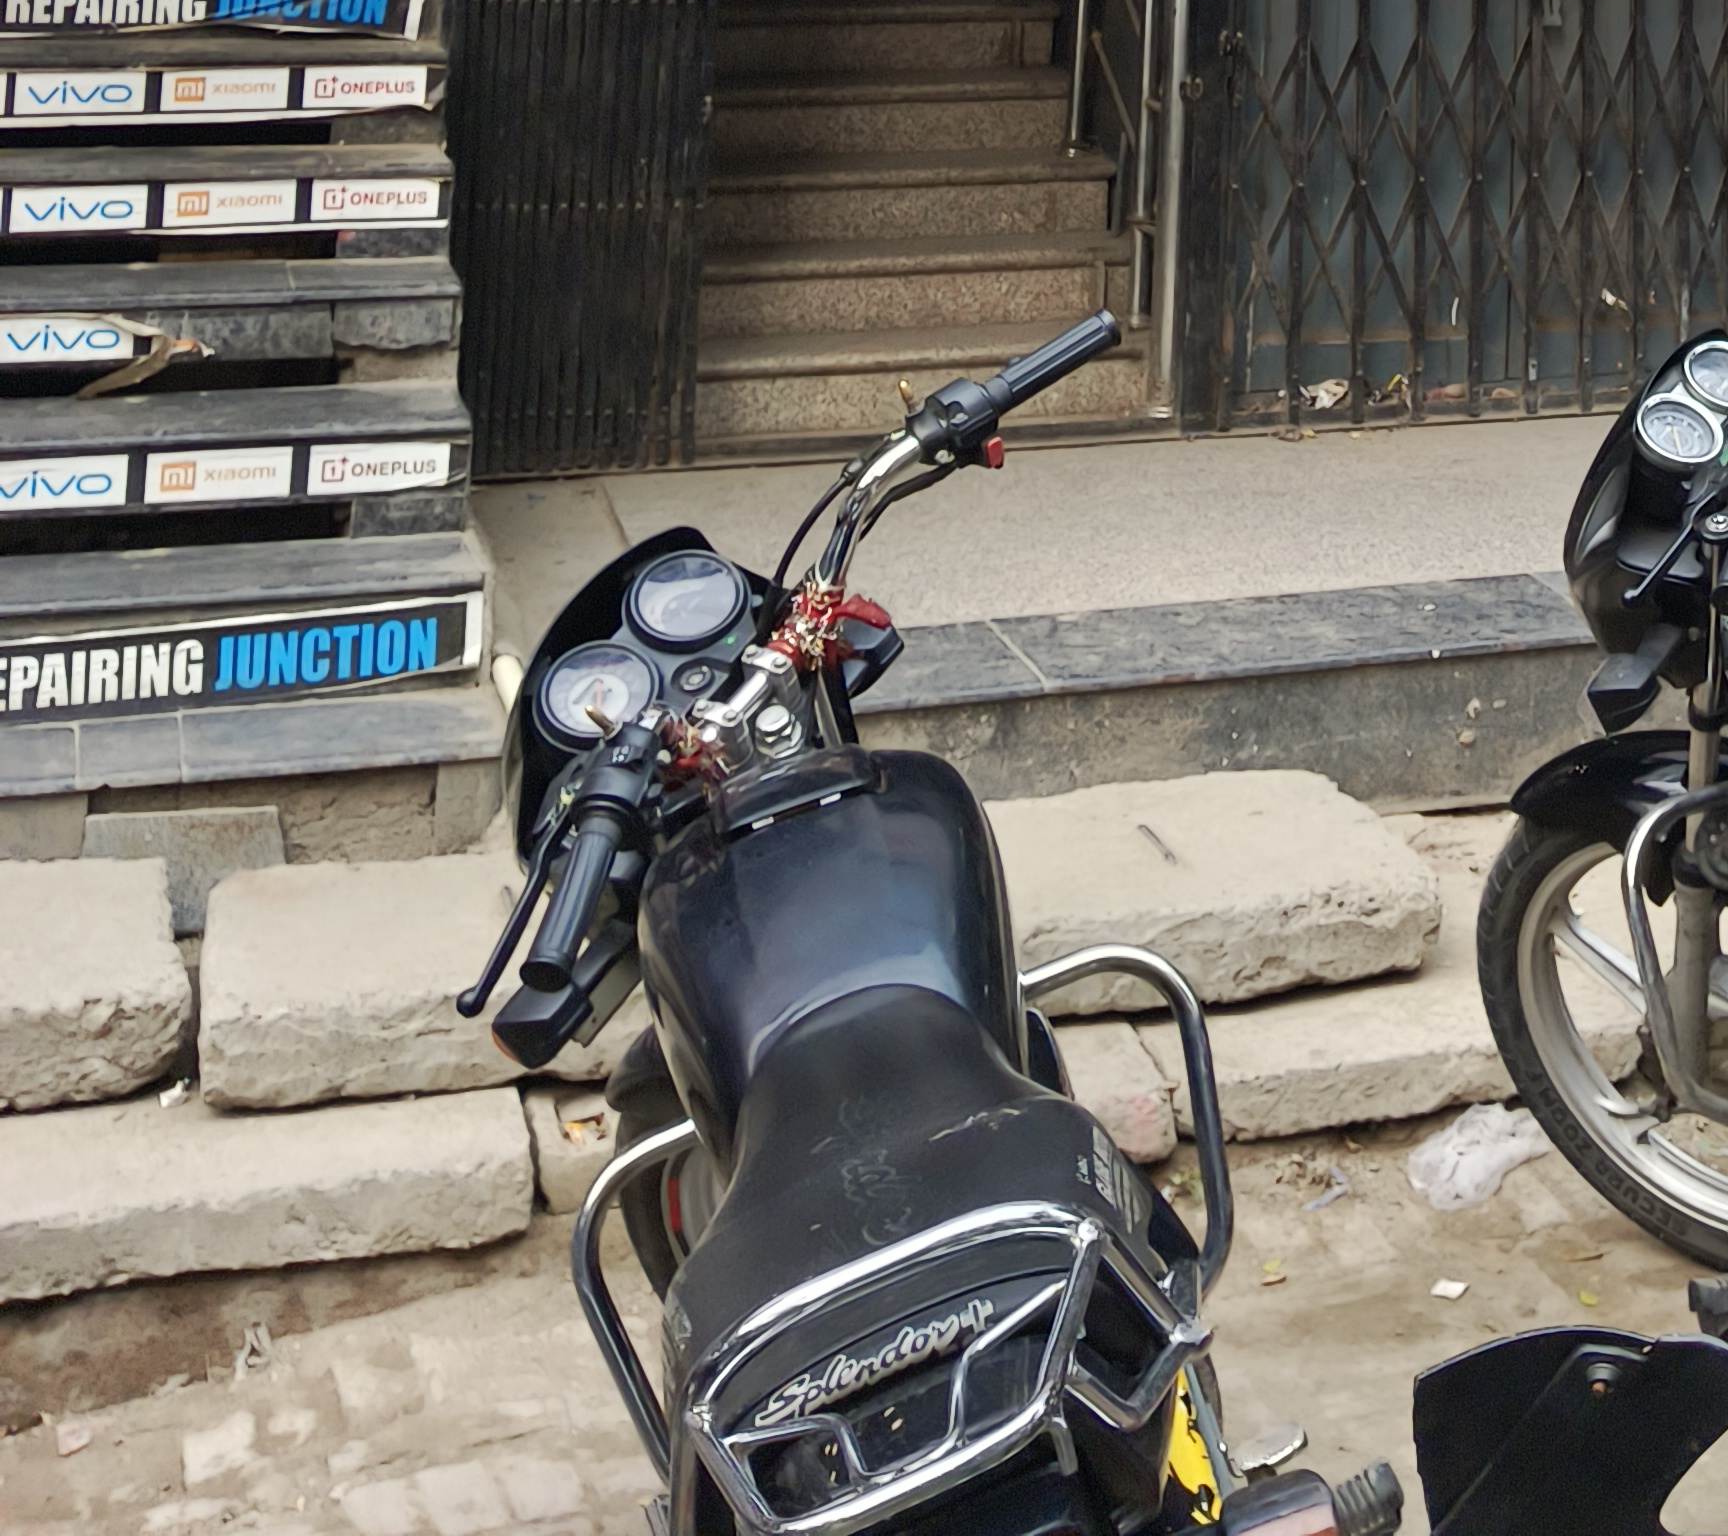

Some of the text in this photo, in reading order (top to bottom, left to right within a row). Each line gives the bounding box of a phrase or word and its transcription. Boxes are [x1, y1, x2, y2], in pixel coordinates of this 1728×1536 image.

[28, 80, 132, 105] vivo
[340, 80, 415, 95] ONEPLUS
[24, 196, 133, 221] vivo
[350, 191, 427, 206] ONEPLUS
[7, 325, 120, 352] vivo
[0, 471, 112, 499] vivo
[351, 459, 436, 477] ONEPLUS
[214, 618, 437, 691] JUNCTION
